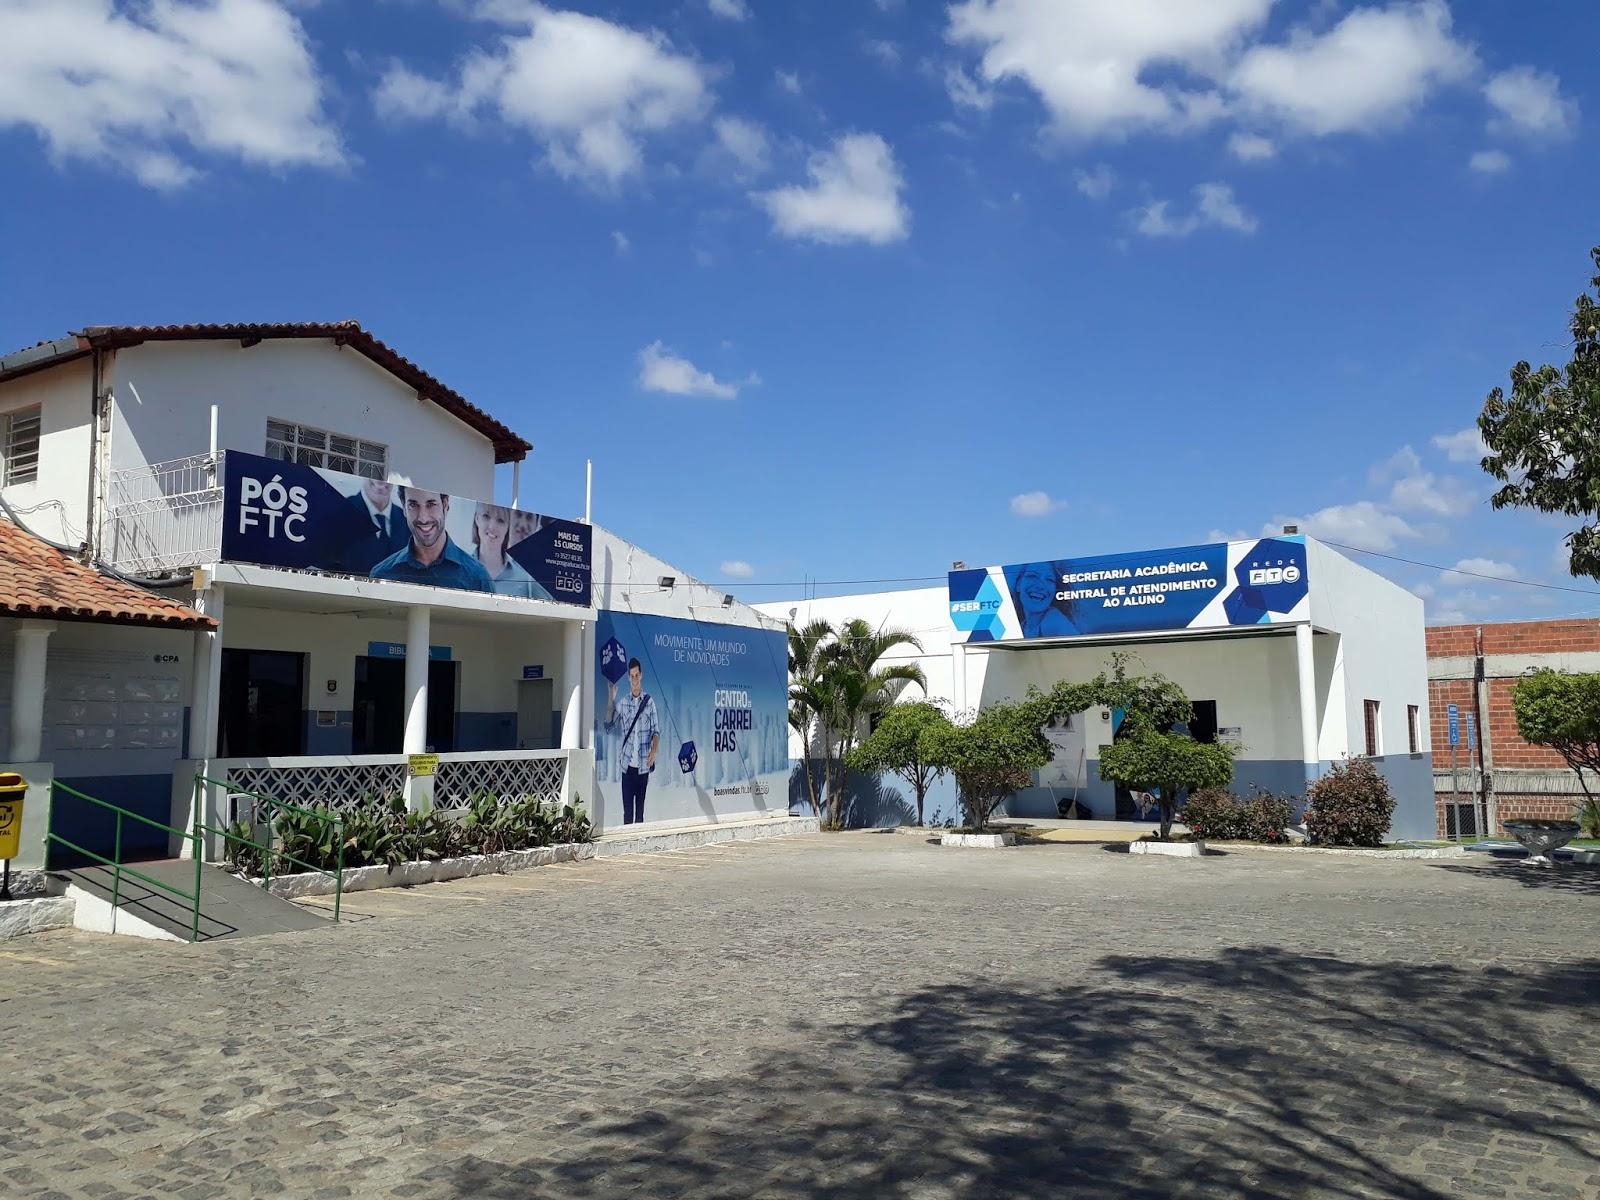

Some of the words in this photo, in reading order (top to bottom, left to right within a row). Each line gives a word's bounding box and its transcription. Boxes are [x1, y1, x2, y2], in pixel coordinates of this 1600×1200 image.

[241, 474, 309, 514] PÓS
[240, 505, 307, 543] FTC
[557, 531, 571, 541] MAIS
[572, 534, 580, 542] DE
[554, 540, 561, 548] 15
[562, 541, 583, 552] CURSOS
[1062, 568, 1131, 584] SECRETARIA
[1135, 561, 1208, 577] ACADÊMICA
[1252, 559, 1295, 568] REDE
[557, 578, 582, 591] FTC
[1252, 568, 1298, 583] FTC
[1055, 587, 1107, 601] CENTRAL
[1111, 586, 1126, 597] DE
[1130, 578, 1217, 595] ATENDIMENTO
[951, 600, 1000, 613] #SERFTC
[1102, 598, 1120, 608] AO
[1123, 594, 1165, 607] ALUNO
[654, 633, 702, 651] MOVIMENTE
[704, 639, 717, 652] UM
[718, 640, 747, 655] MUNDO
[162, 655, 180, 663] CPA
[674, 649, 685, 663] DE
[687, 650, 730, 667] NOVIDADES
[714, 689, 748, 709] CENTRO
[714, 708, 752, 731] CARREI
[714, 730, 736, 753] RAS
